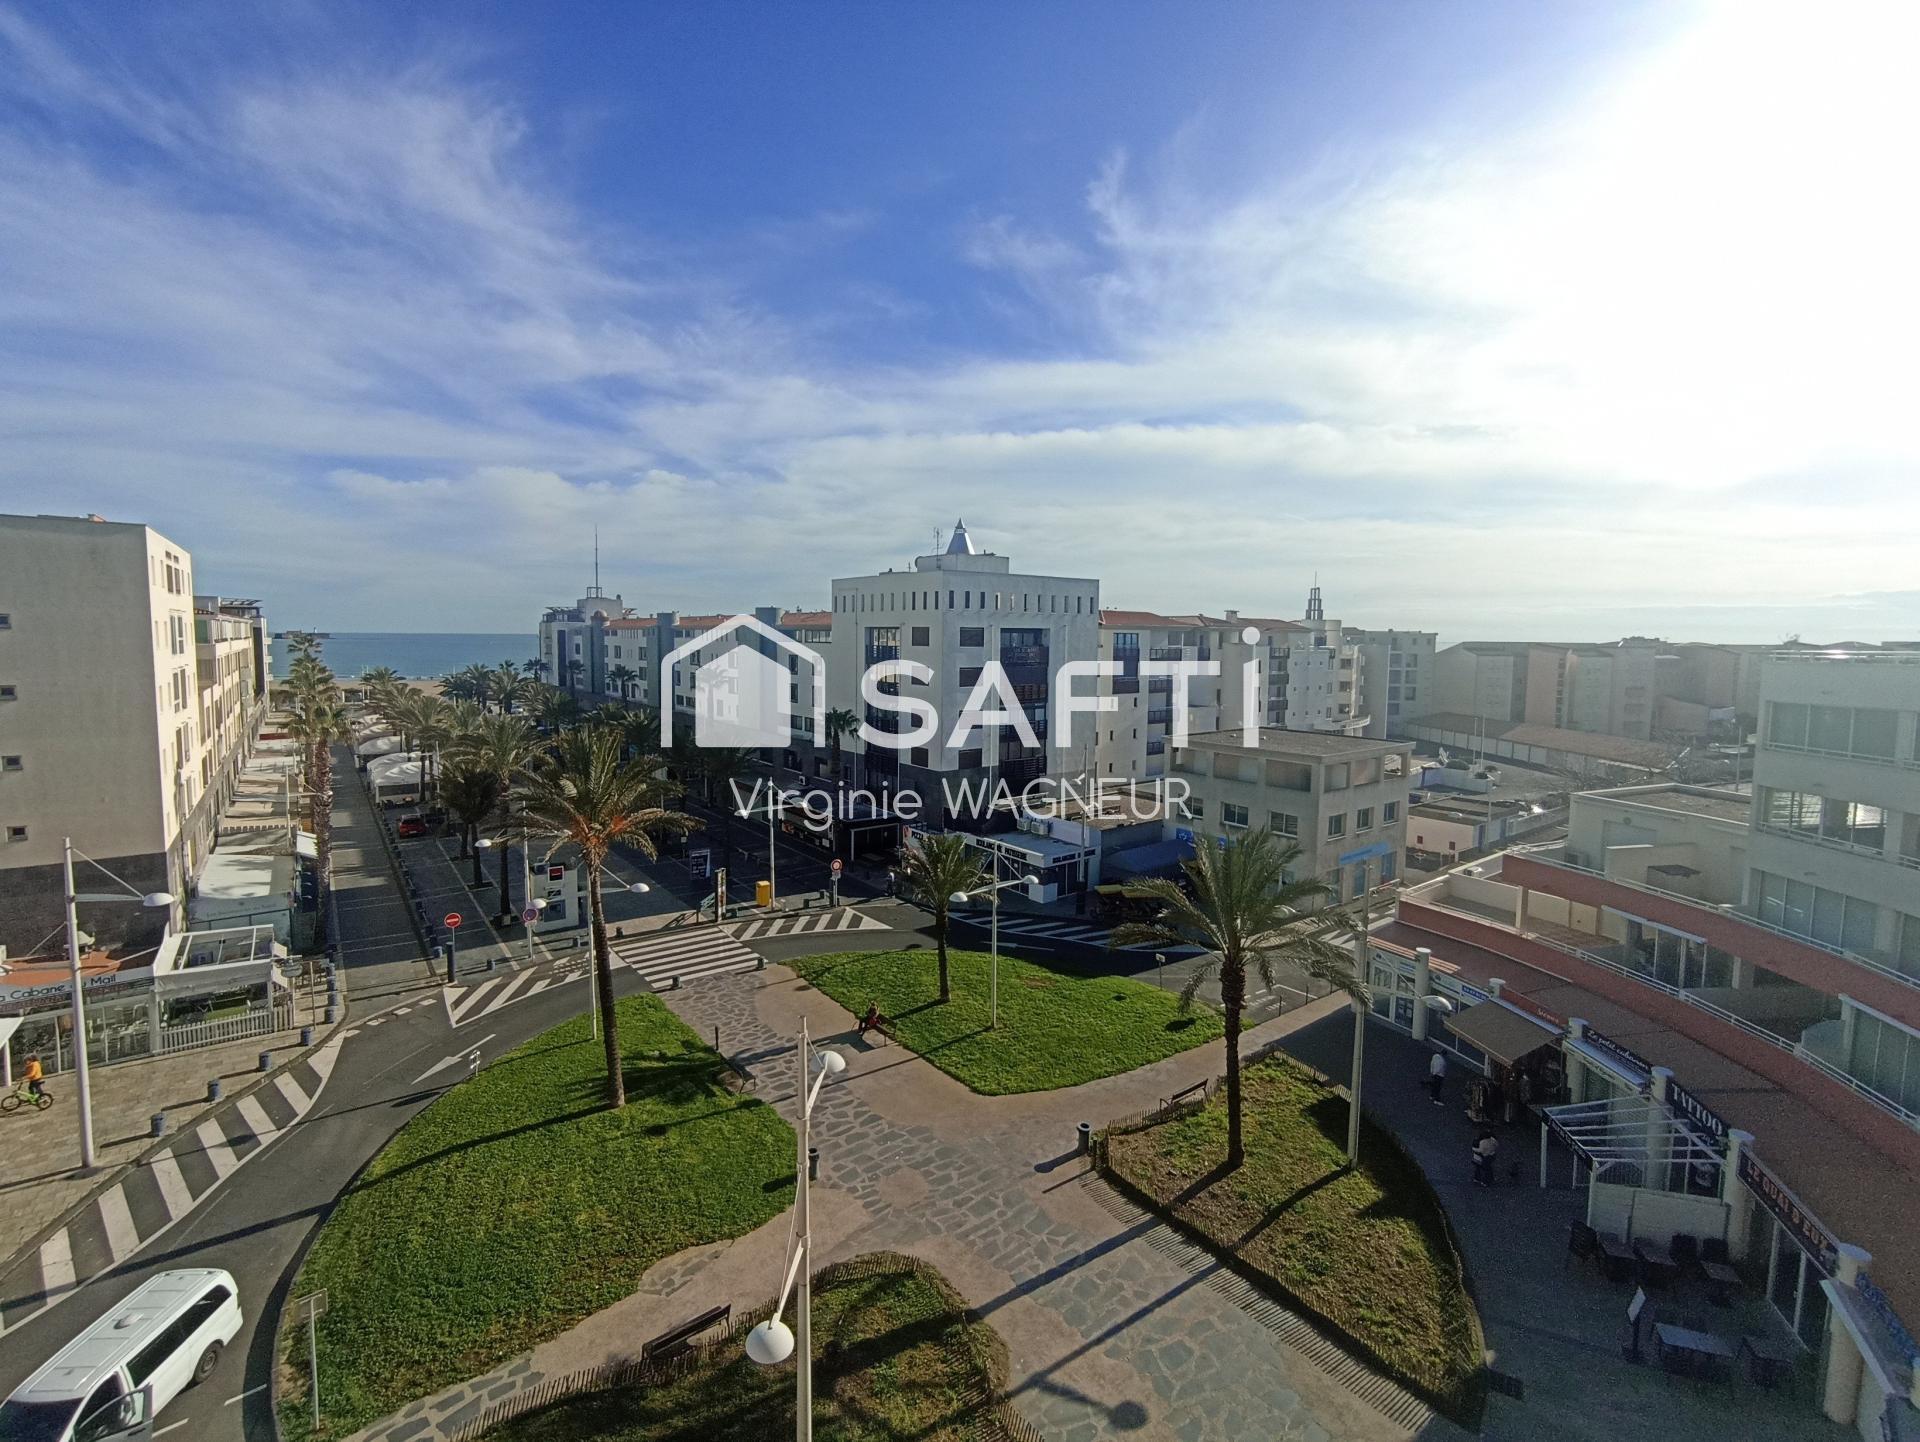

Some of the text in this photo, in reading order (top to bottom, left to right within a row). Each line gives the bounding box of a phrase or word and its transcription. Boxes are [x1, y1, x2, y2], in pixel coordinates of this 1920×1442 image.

[10, 984, 65, 1000] Cabane
[90, 974, 116, 986] Mail
[1671, 1083, 1723, 1136] TATTOO
